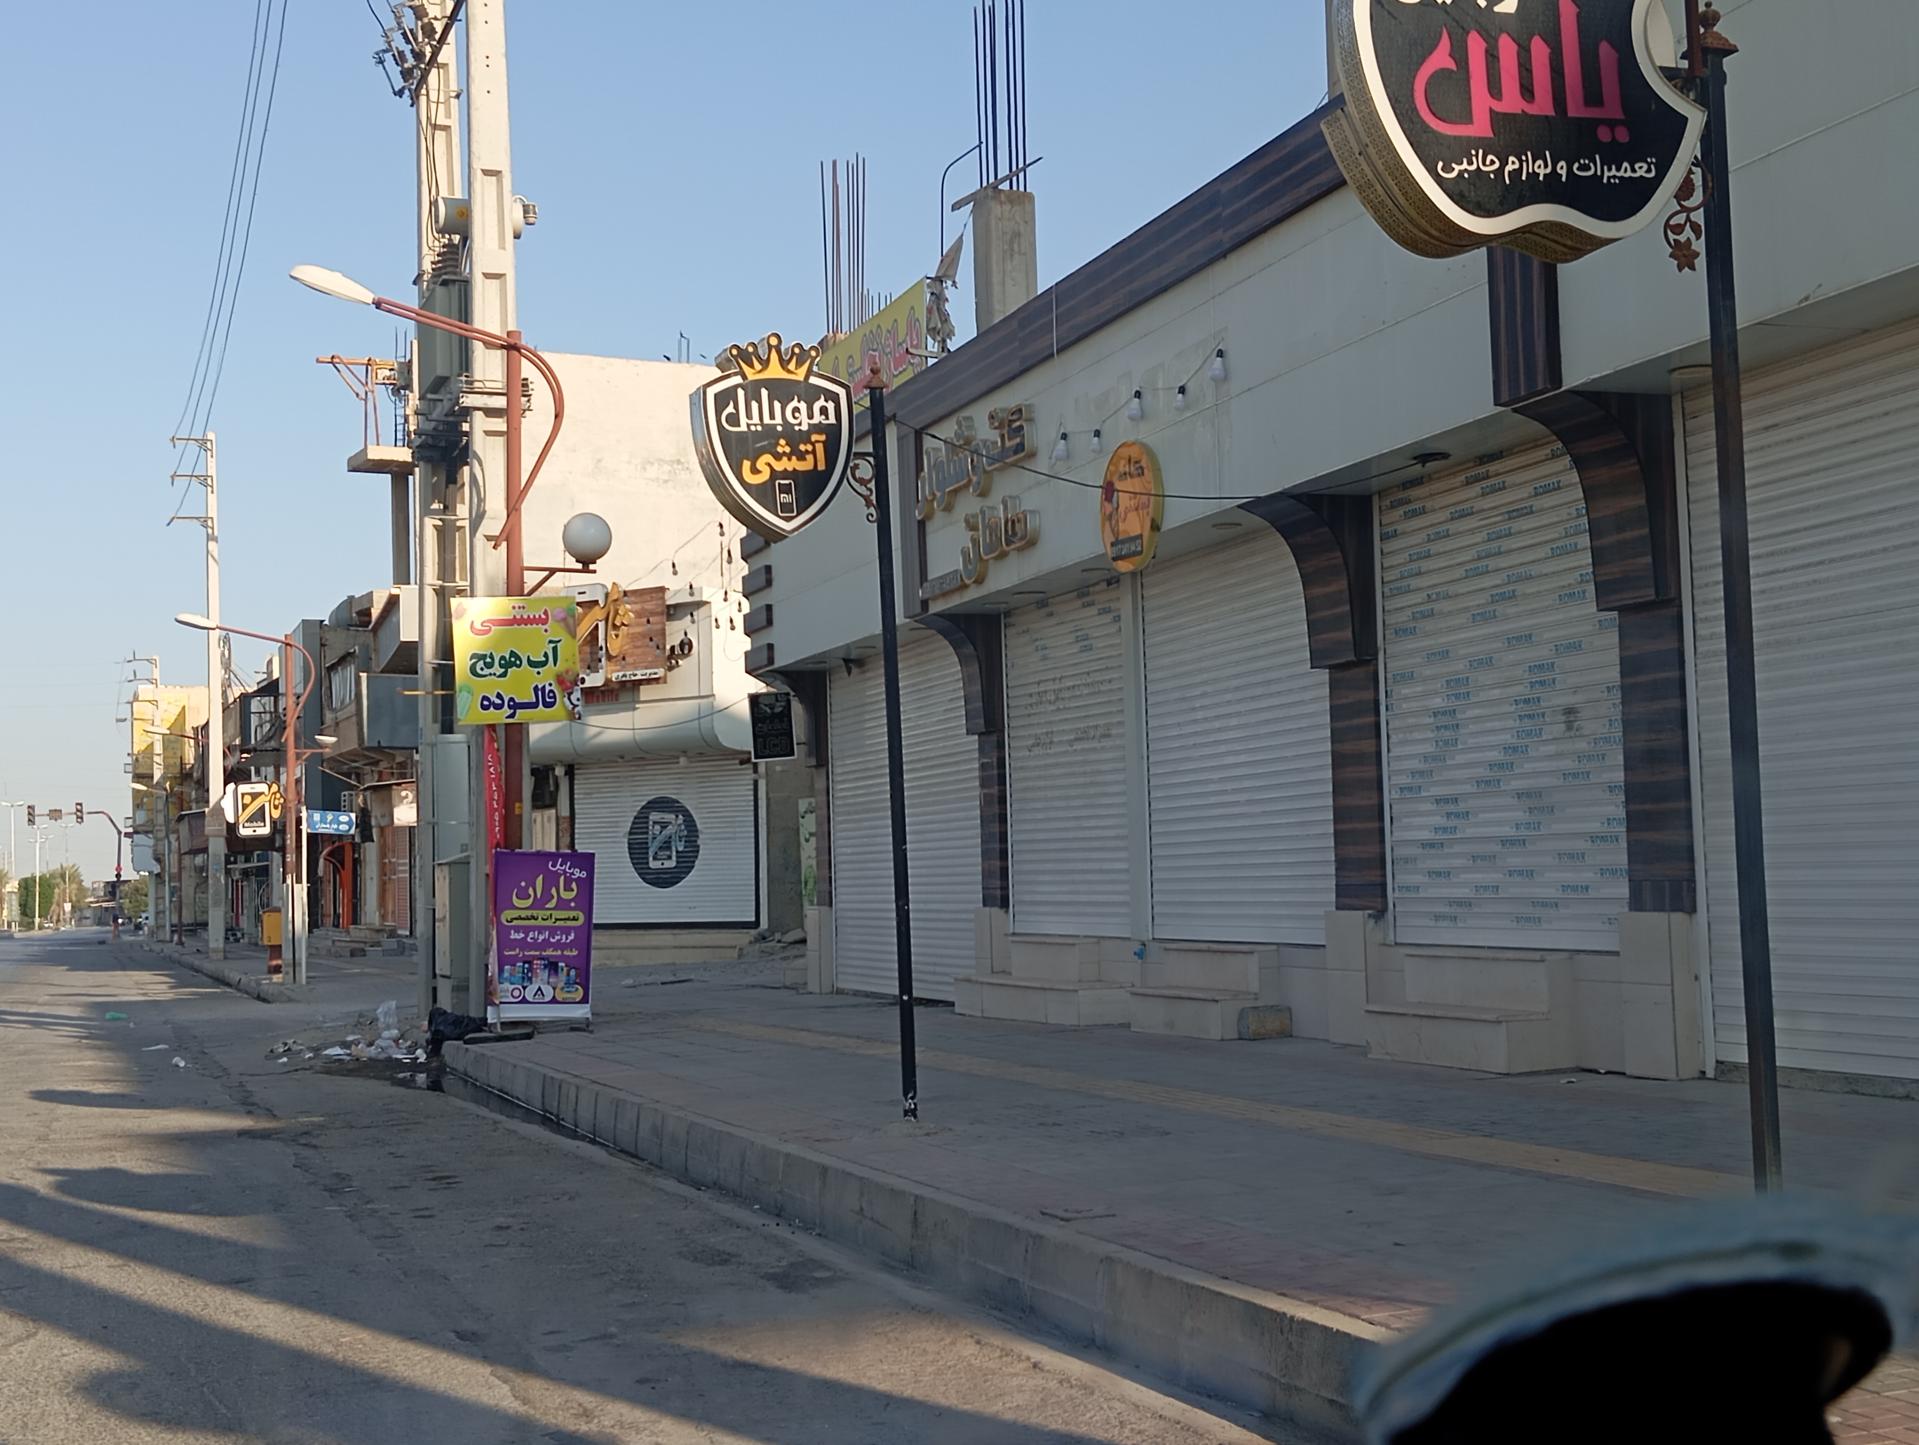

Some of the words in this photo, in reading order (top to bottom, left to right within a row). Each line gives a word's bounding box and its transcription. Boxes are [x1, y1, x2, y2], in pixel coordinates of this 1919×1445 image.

[1413, 0, 1629, 143] یاس
[1437, 148, 1499, 184] جانبی
[1504, 150, 1553, 184] لوازم
[1556, 160, 1568, 183] و
[1572, 150, 1657, 184] تعمیرات
[721, 387, 836, 432] موبایل
[742, 433, 826, 485] آتشی
[470, 605, 550, 636] بستنی
[468, 649, 523, 678] هویج
[527, 638, 562, 676] آب
[479, 682, 558, 719] فالوده
[548, 857, 587, 879] موبایل
[512, 873, 578, 908] باران
[509, 929, 526, 940] خط
[526, 929, 549, 943] انواع
[549, 929, 575, 943] فروش
